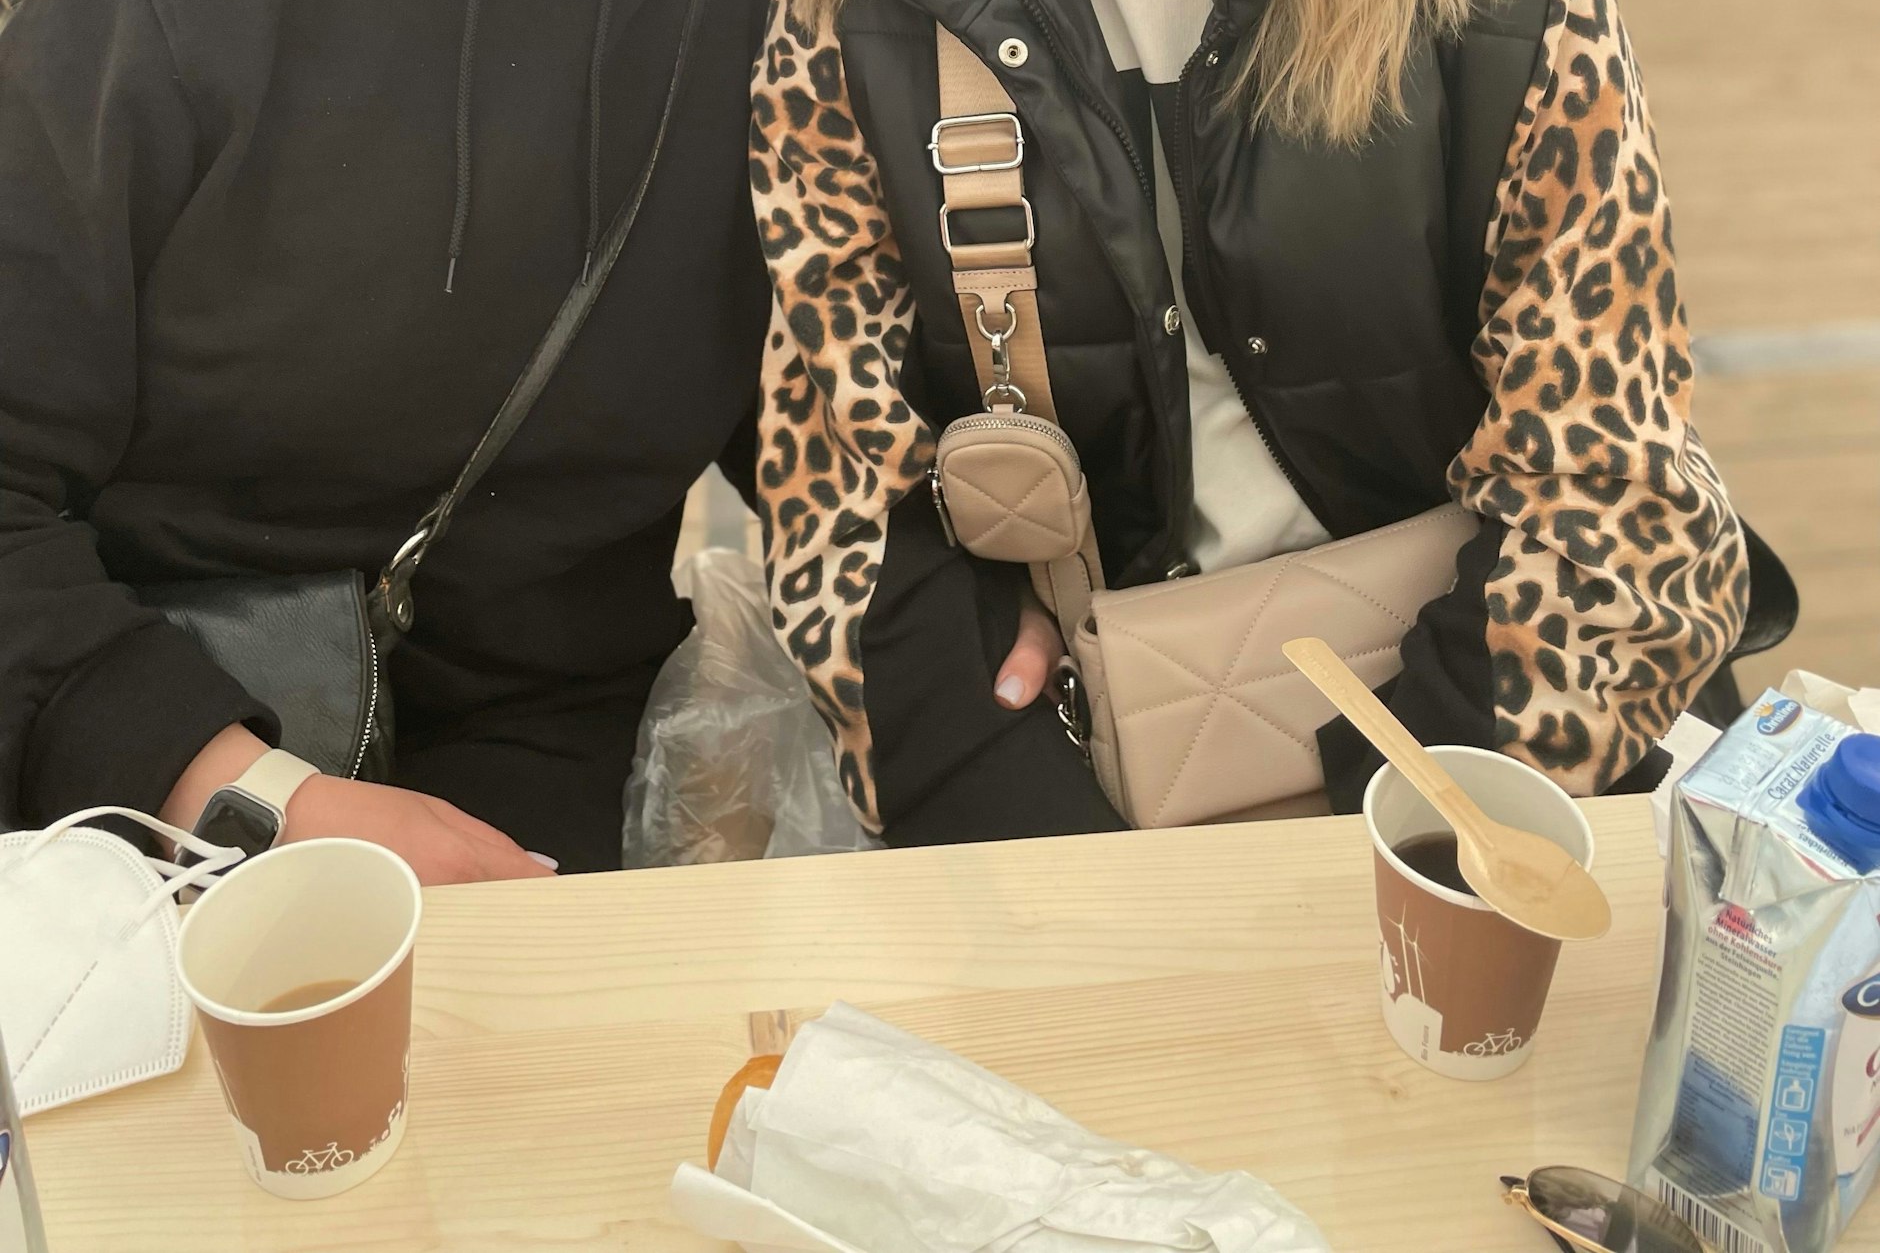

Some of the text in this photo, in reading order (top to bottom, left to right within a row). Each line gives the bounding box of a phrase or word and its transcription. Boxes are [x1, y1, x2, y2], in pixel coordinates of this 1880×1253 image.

[1767, 772, 1799, 801] Carat
[1793, 731, 1836, 778] Naturelle
[1707, 925, 1783, 972] ohne Kohlensäure
[1716, 916, 1777, 958] Mineralwasser
[1725, 908, 1773, 945] Natürliches
